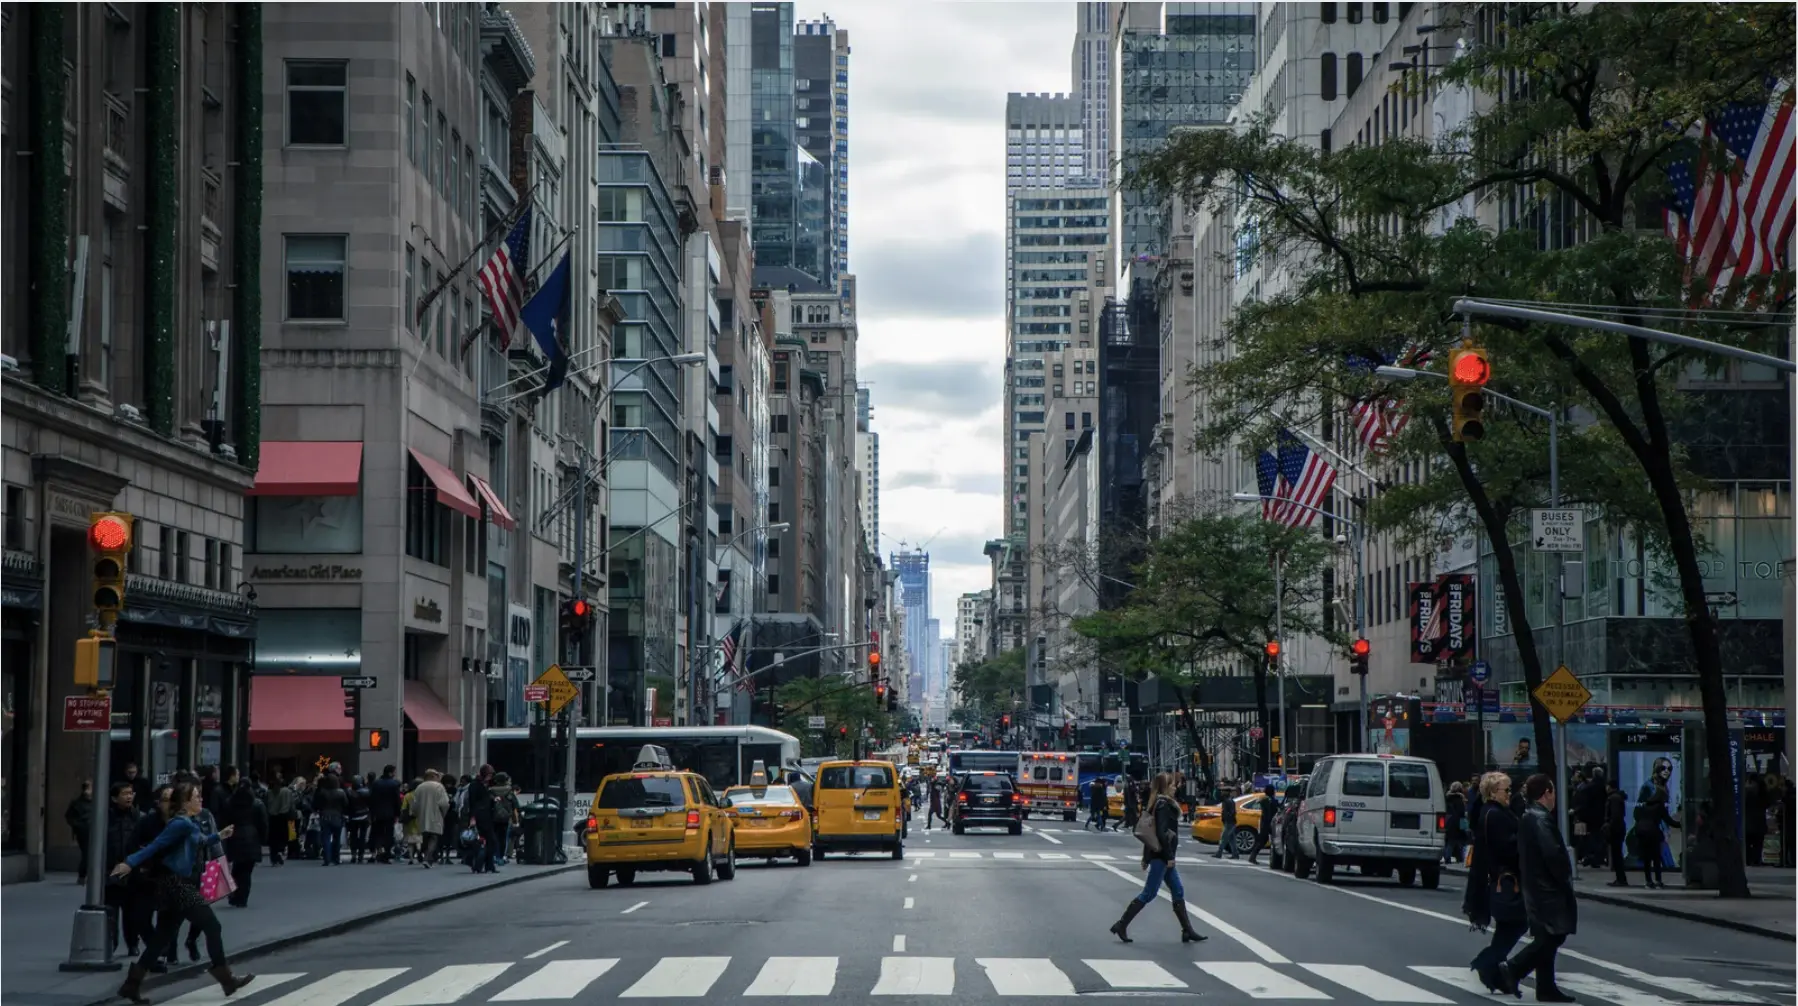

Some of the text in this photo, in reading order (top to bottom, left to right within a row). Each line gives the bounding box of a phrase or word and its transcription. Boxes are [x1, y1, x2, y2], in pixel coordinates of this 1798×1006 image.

[1541, 512, 1574, 521] BUSES
[1545, 527, 1571, 536] ONLY
[251, 563, 362, 580] American Girl Place
[1611, 560, 1725, 579] TOPSOP
[1450, 583, 1462, 591] TGI
[1449, 591, 1462, 649] FRIDAYS
[1420, 599, 1432, 654] FRIDYS
[68, 699, 109, 707] NO STOPPING
[72, 709, 103, 717] ANYTIME
